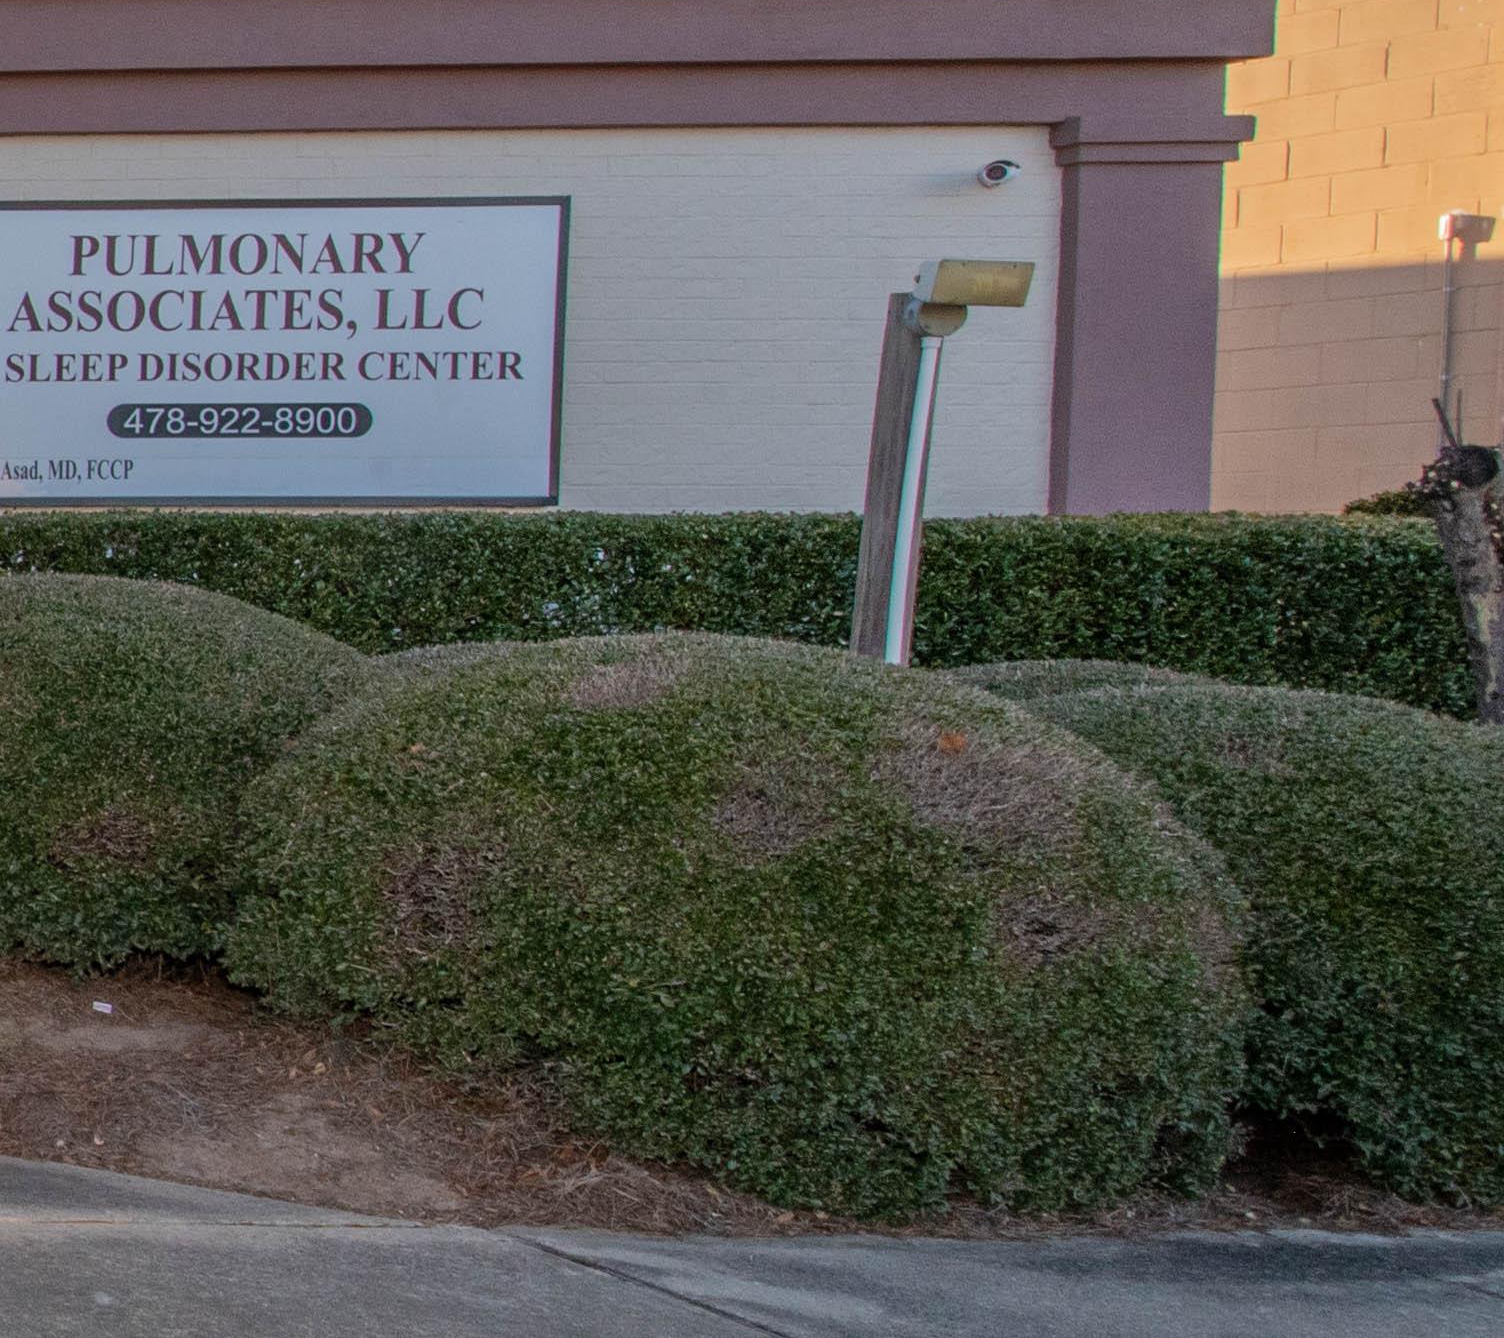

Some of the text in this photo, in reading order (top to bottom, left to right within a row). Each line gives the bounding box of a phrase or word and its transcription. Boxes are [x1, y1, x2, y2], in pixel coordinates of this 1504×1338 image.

[68, 231, 426, 277] PULMONARY
[7, 287, 485, 340] ASSOCIATES, LLC
[5, 353, 128, 383] SLEEP
[137, 352, 347, 382] DISORDER
[357, 351, 525, 381] CENTER
[123, 407, 357, 435] 478-922-8900
[0, 460, 43, 483] Asad,
[48, 460, 82, 483] MD,
[87, 459, 134, 480] FCCP
